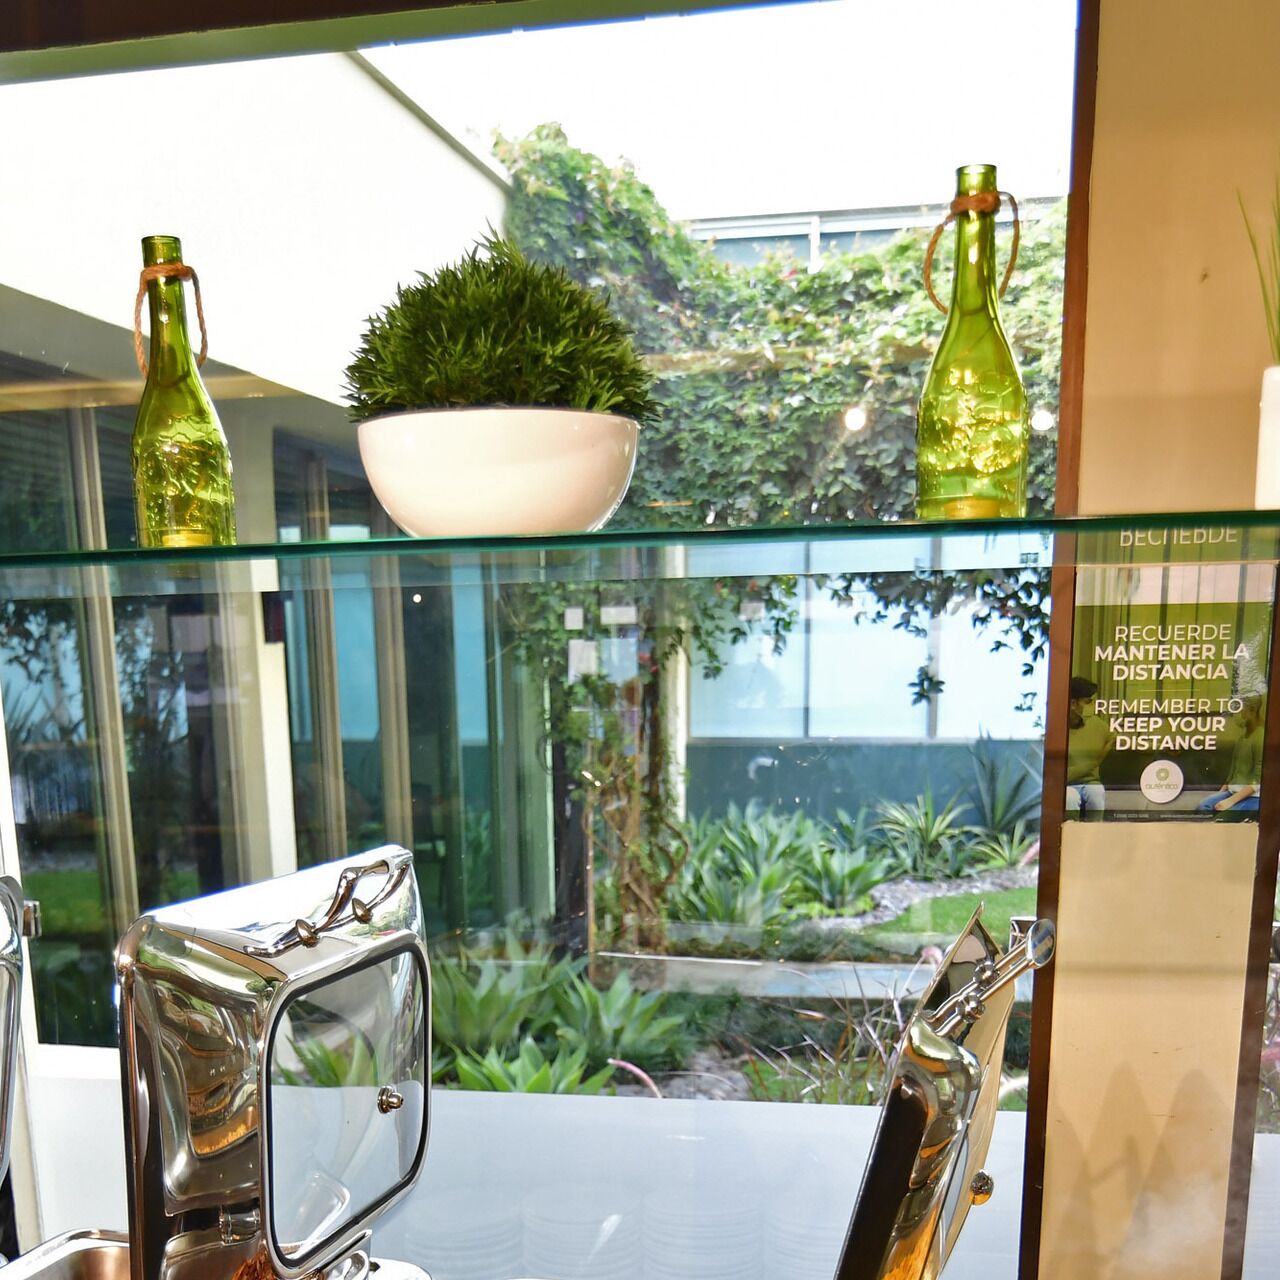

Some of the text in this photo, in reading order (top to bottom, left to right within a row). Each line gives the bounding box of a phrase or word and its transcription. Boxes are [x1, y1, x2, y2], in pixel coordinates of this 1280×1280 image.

[1114, 624, 1232, 642] RECUERDE
[1094, 643, 1250, 662] MANTENER LA
[1112, 663, 1229, 681] DISTANCIA
[1094, 698, 1244, 715] REMEMBER TO
[1109, 716, 1226, 733] KEEP YOUR
[1115, 735, 1217, 751] DISTANCE
